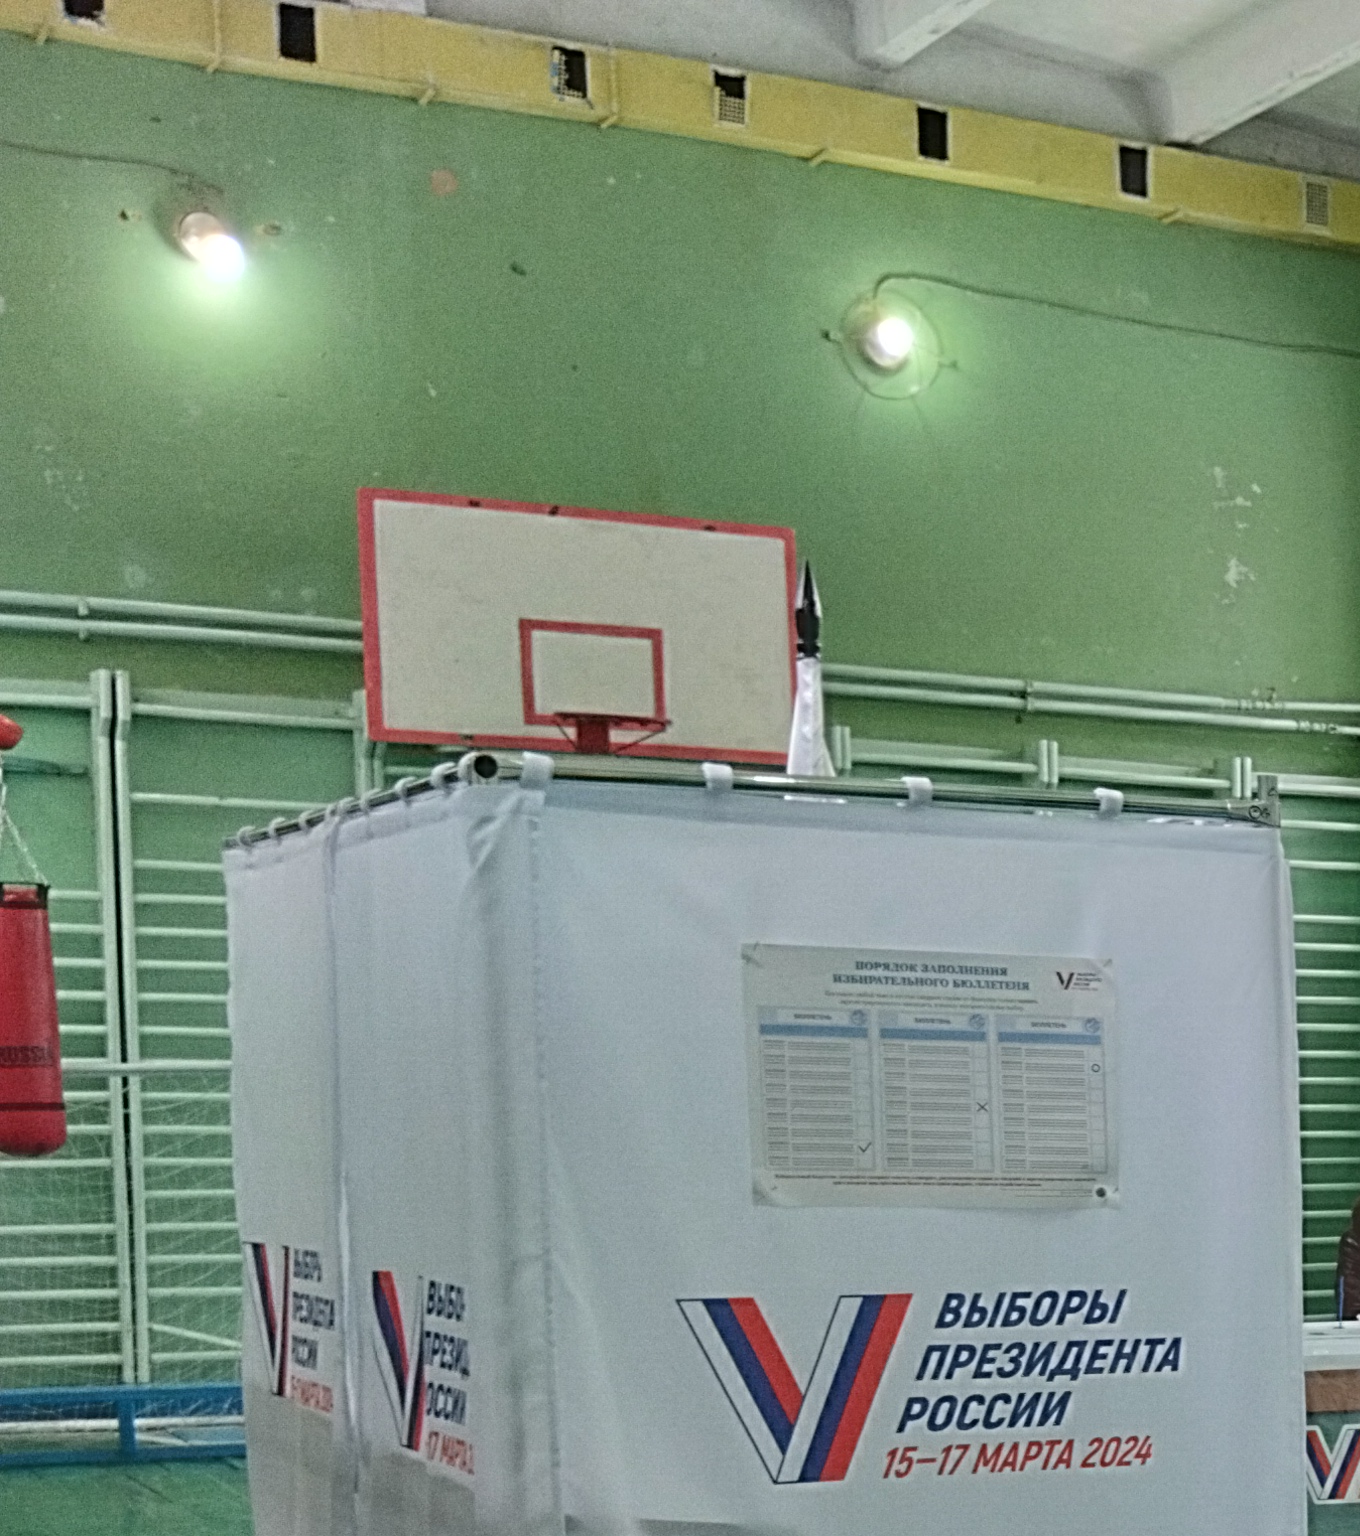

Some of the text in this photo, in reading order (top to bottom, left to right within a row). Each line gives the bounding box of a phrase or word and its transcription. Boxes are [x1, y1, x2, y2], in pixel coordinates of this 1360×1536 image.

[833, 974, 1030, 991] ИЗБИРАТЕЛЬНОГО БЮЛЛЕТЕНЯ
[855, 961, 1008, 976] ПОРЯДОК ЗАПОЛНЕНИЯ
[934, 1288, 1128, 1330] ВЫБОРЫ
[915, 1336, 1182, 1382] ПРЕЗИДЕНТА
[896, 1390, 1073, 1434] РОССИИ
[971, 1438, 1075, 1475] МАРТА
[1080, 1435, 1153, 1469] 2024
